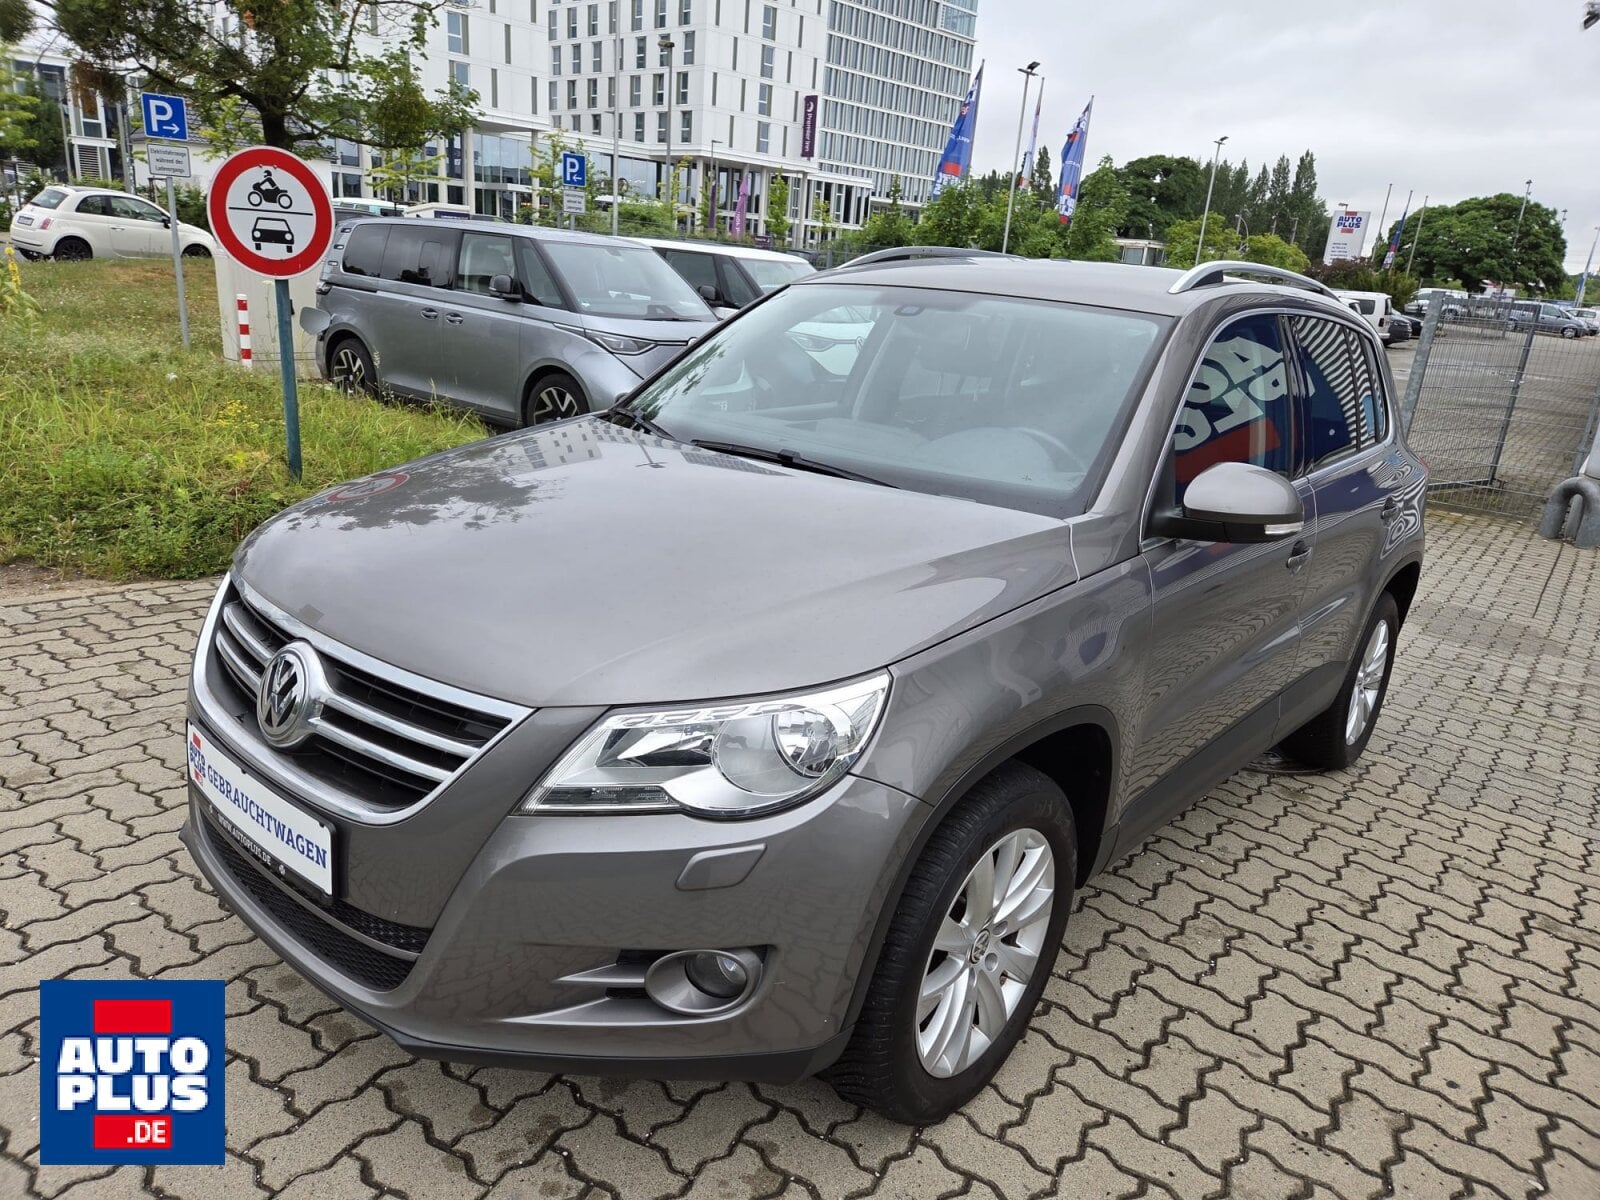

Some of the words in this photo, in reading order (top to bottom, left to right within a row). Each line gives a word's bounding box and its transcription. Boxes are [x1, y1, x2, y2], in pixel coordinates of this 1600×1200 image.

[149, 99, 173, 132] P
[566, 157, 580, 181] P
[207, 764, 327, 869] GEBRAUCHTWAGEN
[217, 812, 272, 866] WWW.AUTOPLUS.DE
